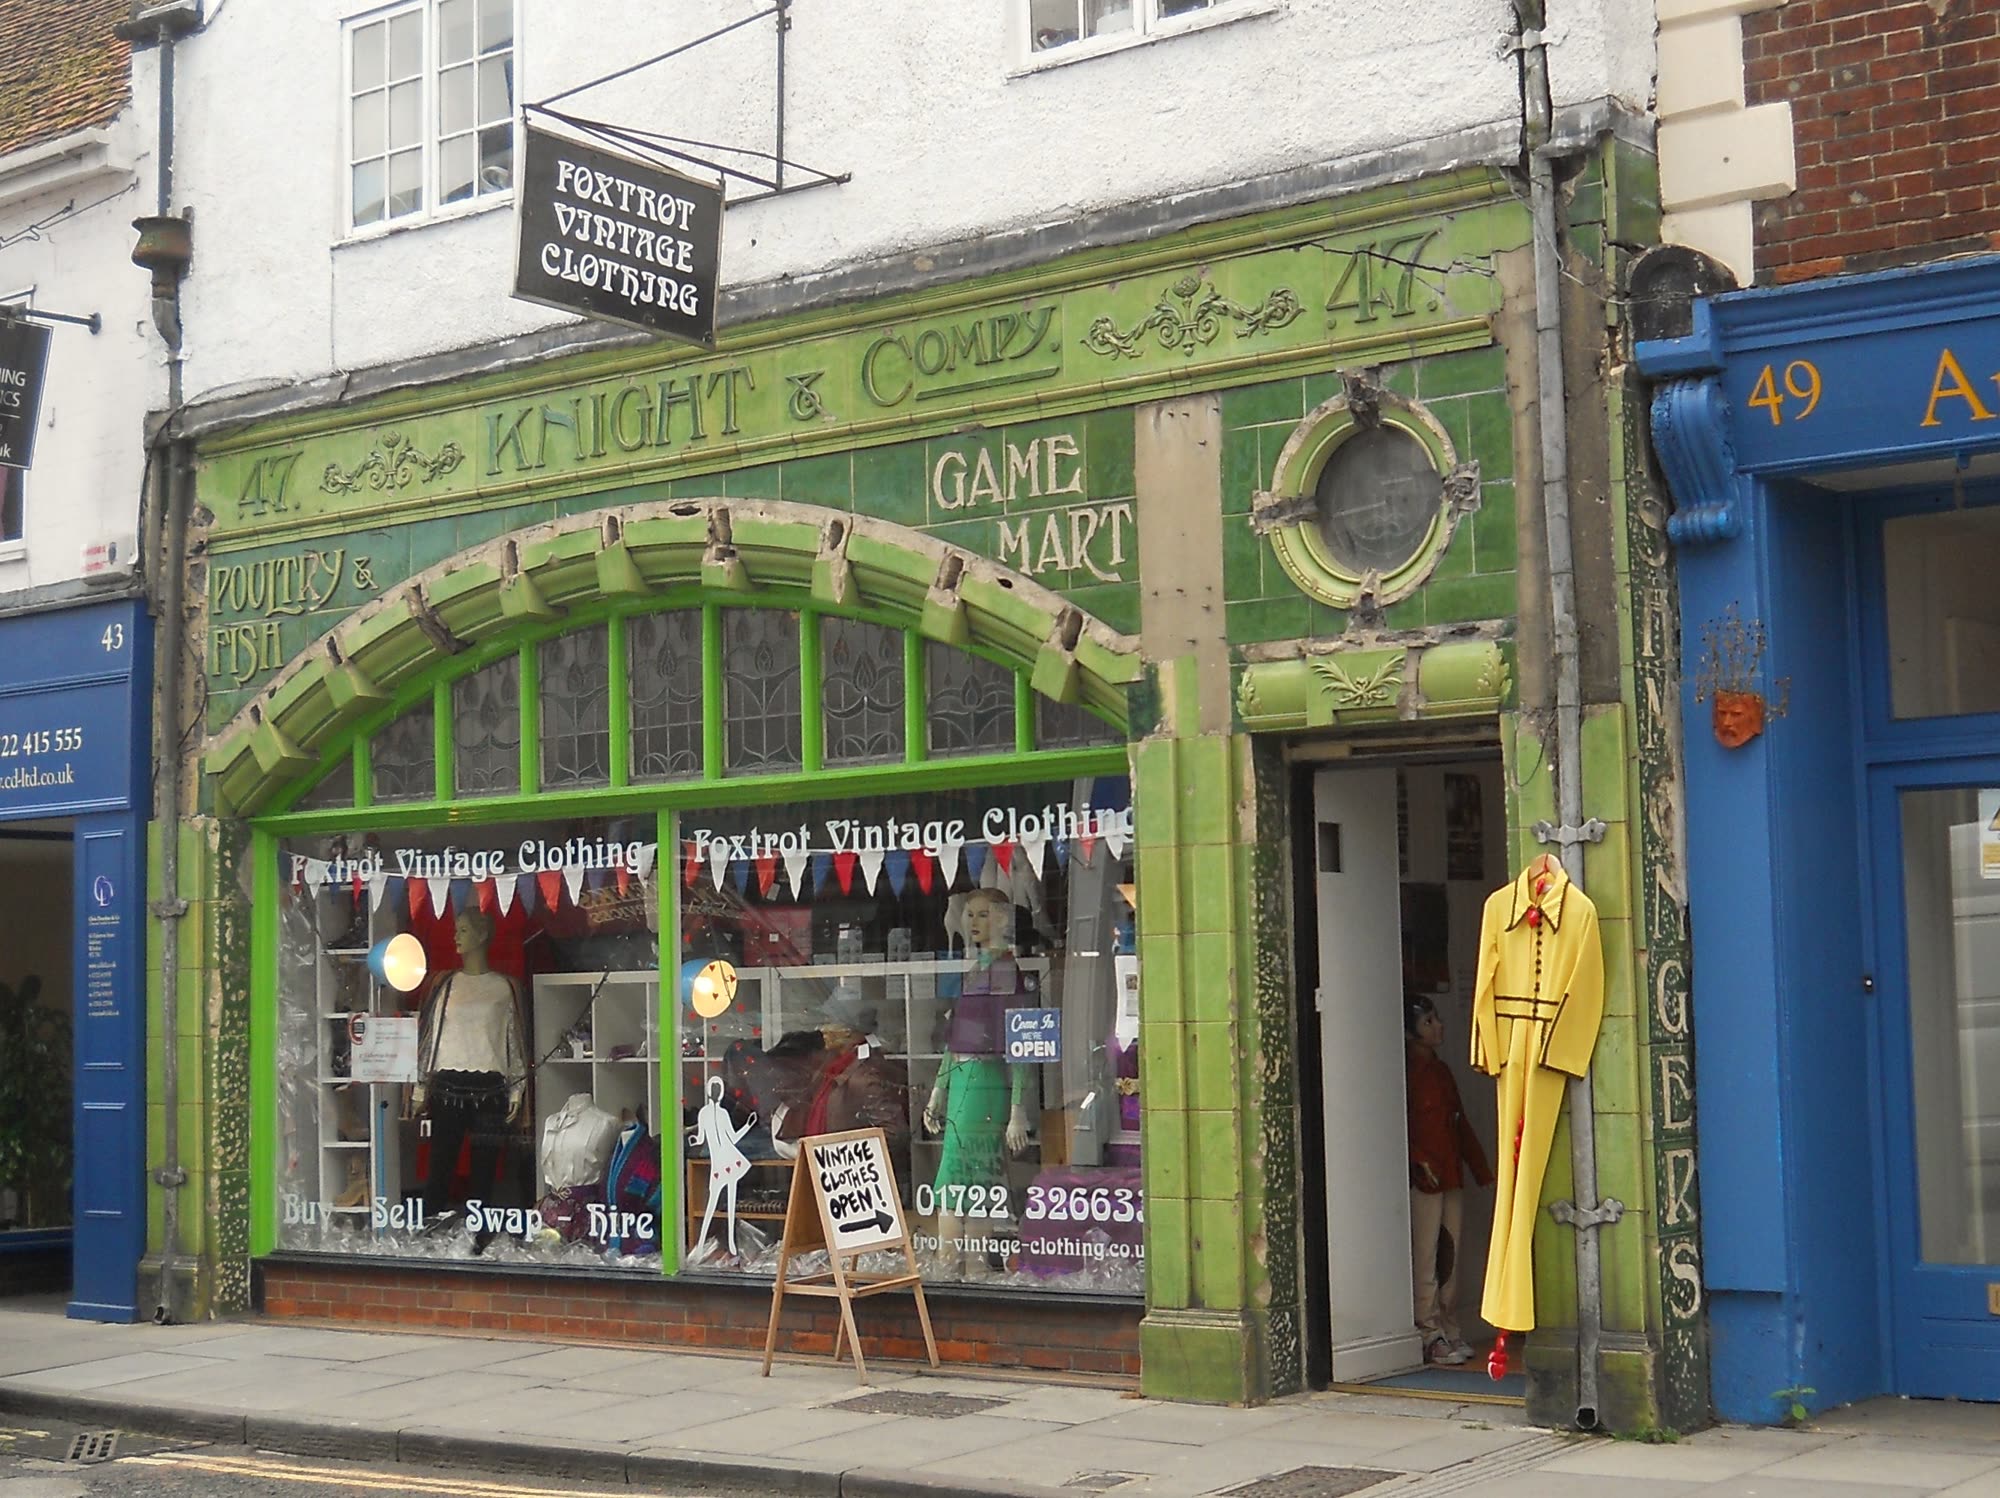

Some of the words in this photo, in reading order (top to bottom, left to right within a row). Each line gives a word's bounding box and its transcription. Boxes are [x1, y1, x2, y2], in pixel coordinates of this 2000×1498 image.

[556, 160, 696, 231] FOXTROT
[553, 202, 694, 273] VINTAGE
[541, 243, 698, 316] CLOTHING
[1747, 359, 1822, 426] 49
[1920, 348, 2000, 426] A
[487, 366, 755, 476] KNIGHT
[783, 369, 828, 421] &
[933, 434, 1084, 510] GAME
[997, 504, 1132, 582] MART
[212, 549, 345, 617] POULTRY
[352, 556, 379, 590] &
[102, 623, 123, 652] 43
[212, 622, 284, 685] FISH
[23, 731, 50, 756] 415
[54, 727, 82, 752] 555
[0, 763, 74, 790] .cd-ltd.co.uk
[291, 850, 384, 885] Foxtrot
[395, 845, 505, 883] Vintage
[519, 836, 644, 874] Clothing
[694, 823, 811, 863] Foxtrot
[826, 816, 965, 857] Vintage
[1010, 1040, 1056, 1057] OPEN
[814, 1141, 874, 1169] VINTAGE
[821, 1163, 879, 1193] CLOTHES
[283, 1193, 335, 1233] Buy
[373, 1197, 425, 1230] Sell
[465, 1199, 543, 1242] Swap
[915, 1184, 1010, 1219] 01722
